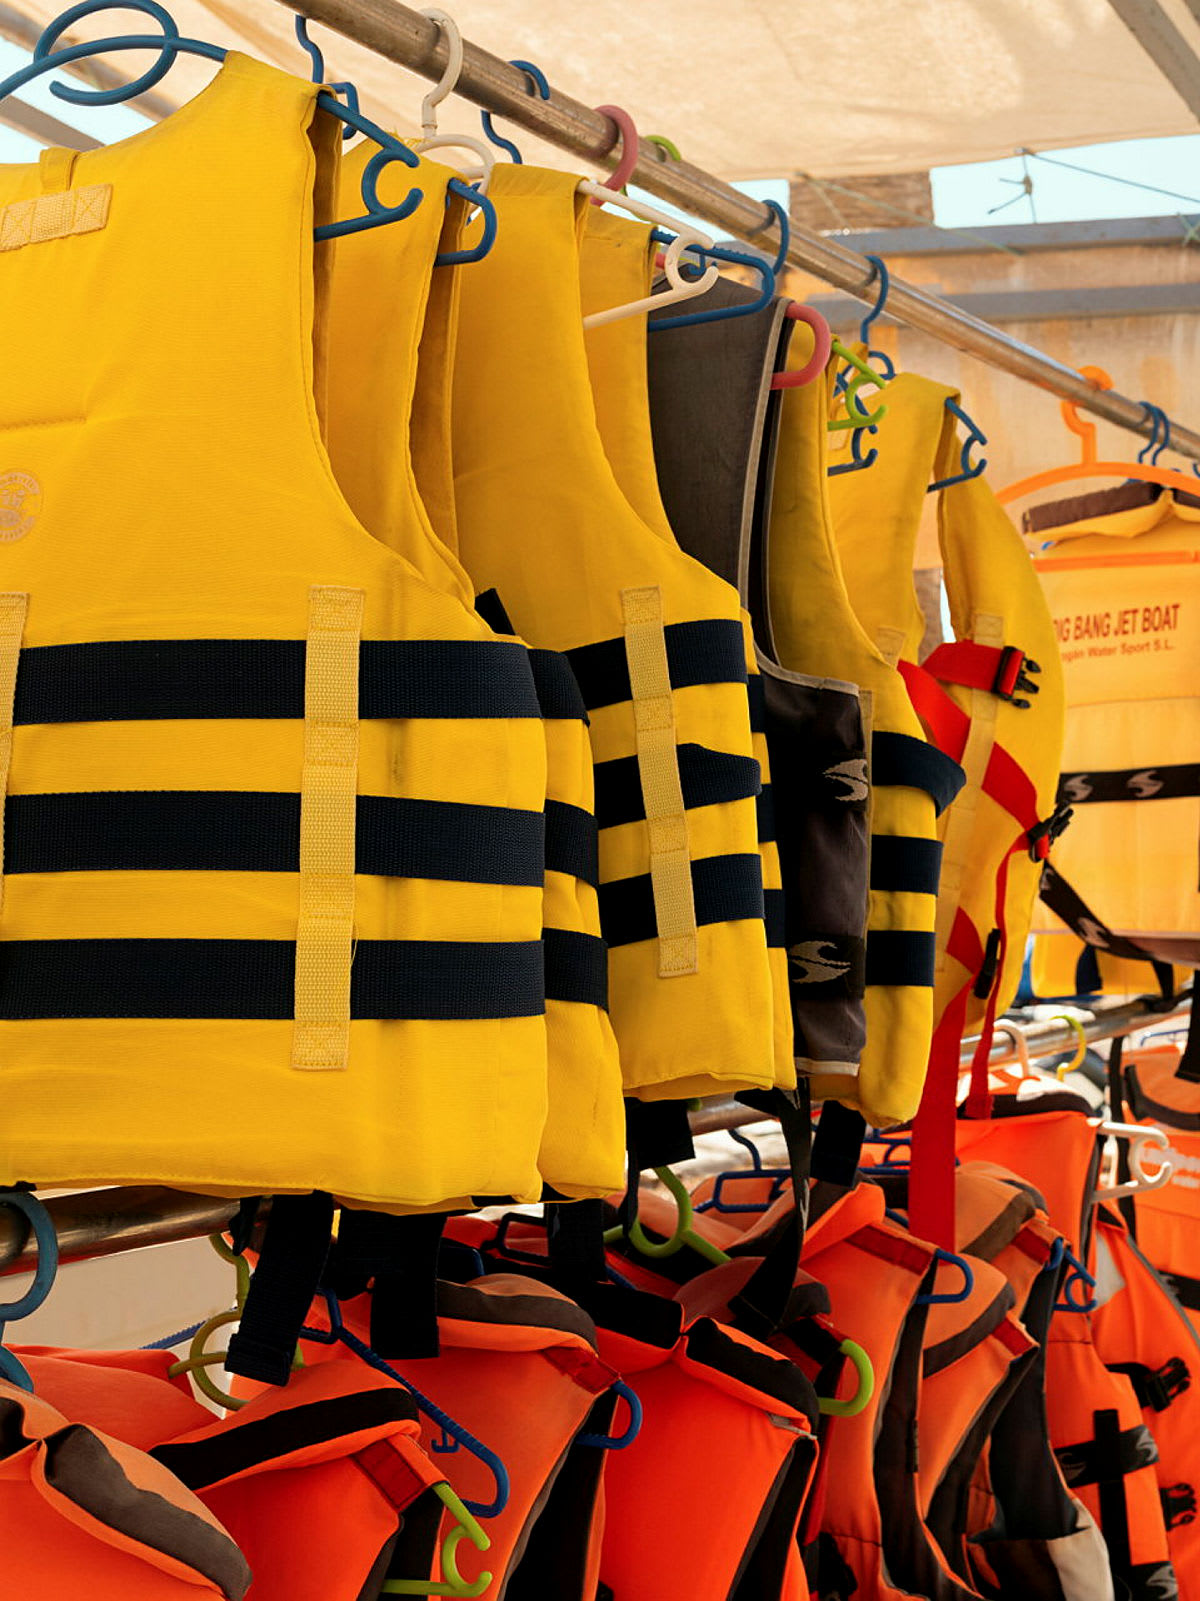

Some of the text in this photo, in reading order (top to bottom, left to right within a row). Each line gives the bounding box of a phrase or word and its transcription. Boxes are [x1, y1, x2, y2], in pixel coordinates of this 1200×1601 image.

[1073, 611, 1111, 641] BANG
[1113, 607, 1139, 636] JET
[1141, 603, 1181, 633] BOAT
